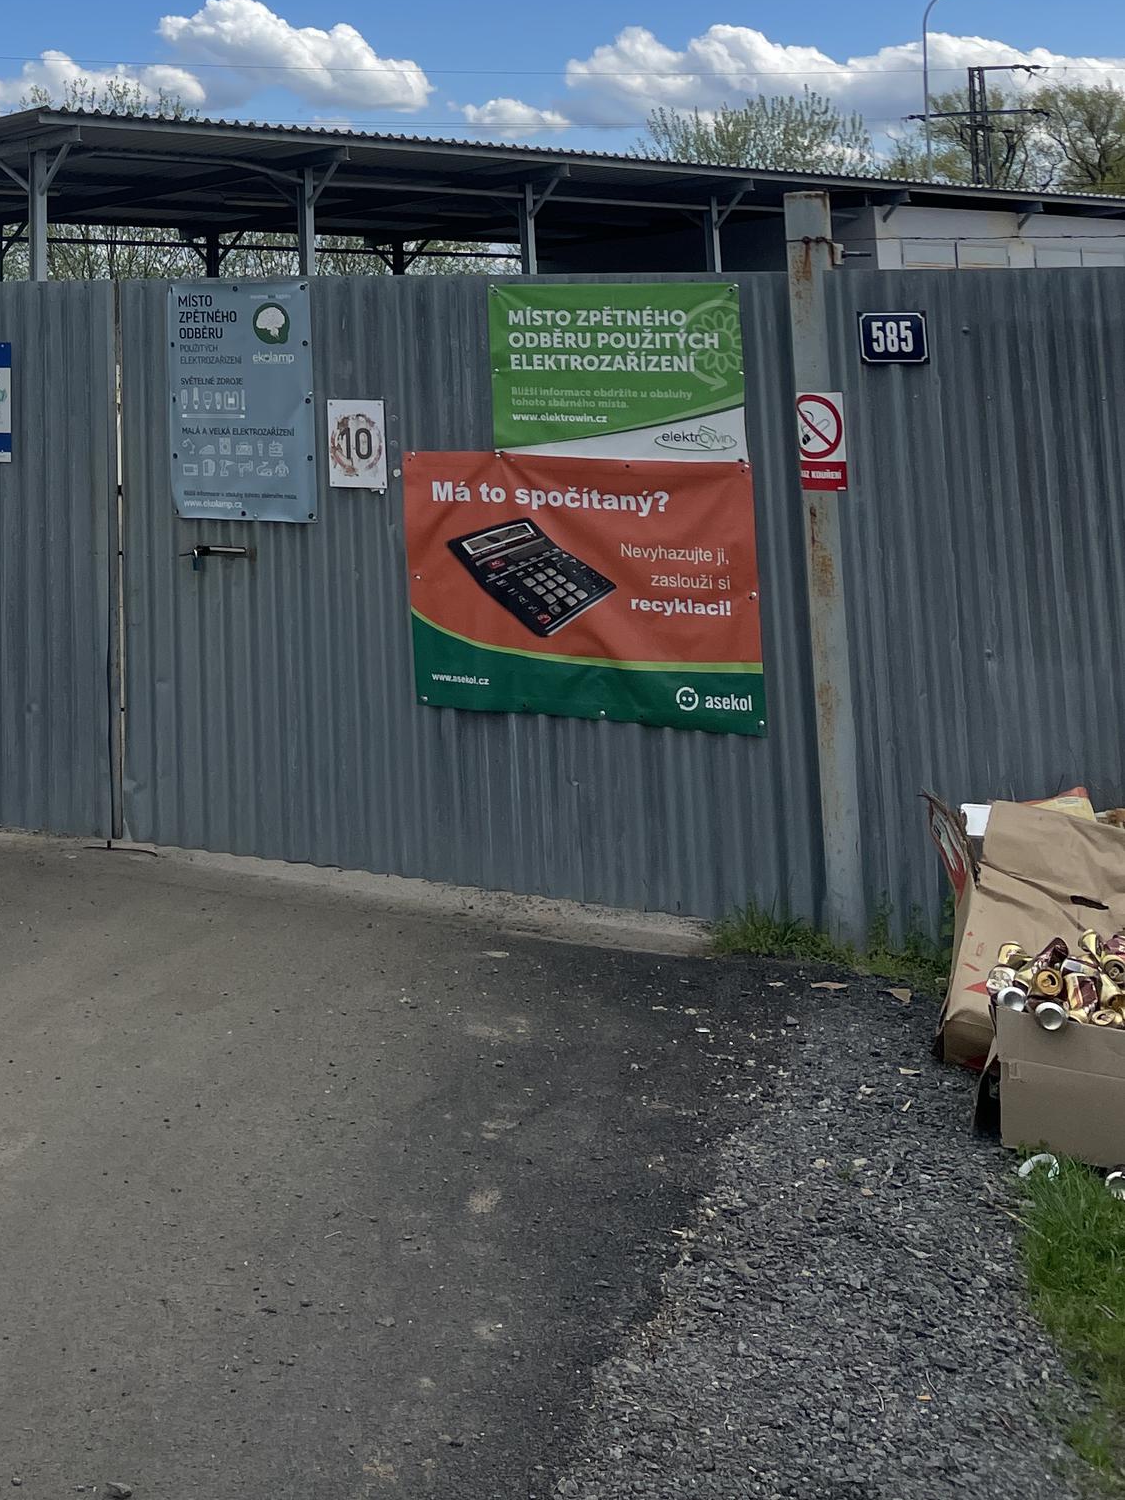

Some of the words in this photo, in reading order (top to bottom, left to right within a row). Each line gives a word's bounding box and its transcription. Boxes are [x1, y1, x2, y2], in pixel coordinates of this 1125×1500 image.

[178, 293, 213, 307] MÍSTO
[179, 309, 237, 323] ZPĚTNÉHO
[508, 307, 571, 326] MÍSTO
[575, 306, 687, 326] ZPĚTNÉHO
[179, 325, 223, 339] ODBĚRU
[508, 329, 591, 348] ODBĚRU
[597, 329, 719, 349] POUŽITÝCH
[871, 321, 914, 353] 585
[252, 351, 295, 365] ekolamp
[510, 351, 696, 372] ELEKTROZAŘÍZENÍ
[539, 387, 591, 397] informace
[650, 389, 693, 400] obsluhy
[511, 398, 546, 407] tohoto
[548, 399, 597, 409] sběrného
[512, 413, 608, 423] www.elektrowin.cz
[339, 427, 373, 460] 10
[661, 431, 733, 444] elektrowin
[183, 500, 242, 509] www.ekolamp.cz
[431, 481, 471, 502] Má
[479, 482, 506, 503] to
[514, 486, 670, 517] spočítaný?
[620, 543, 713, 565] Nevyhazujte
[717, 547, 730, 566] ji,
[650, 574, 713, 590] zaslouží
[718, 576, 731, 591] si
[630, 598, 732, 616] recyklaci!
[431, 672, 490, 686] www.asekol.cz
[705, 692, 753, 712] asekol
